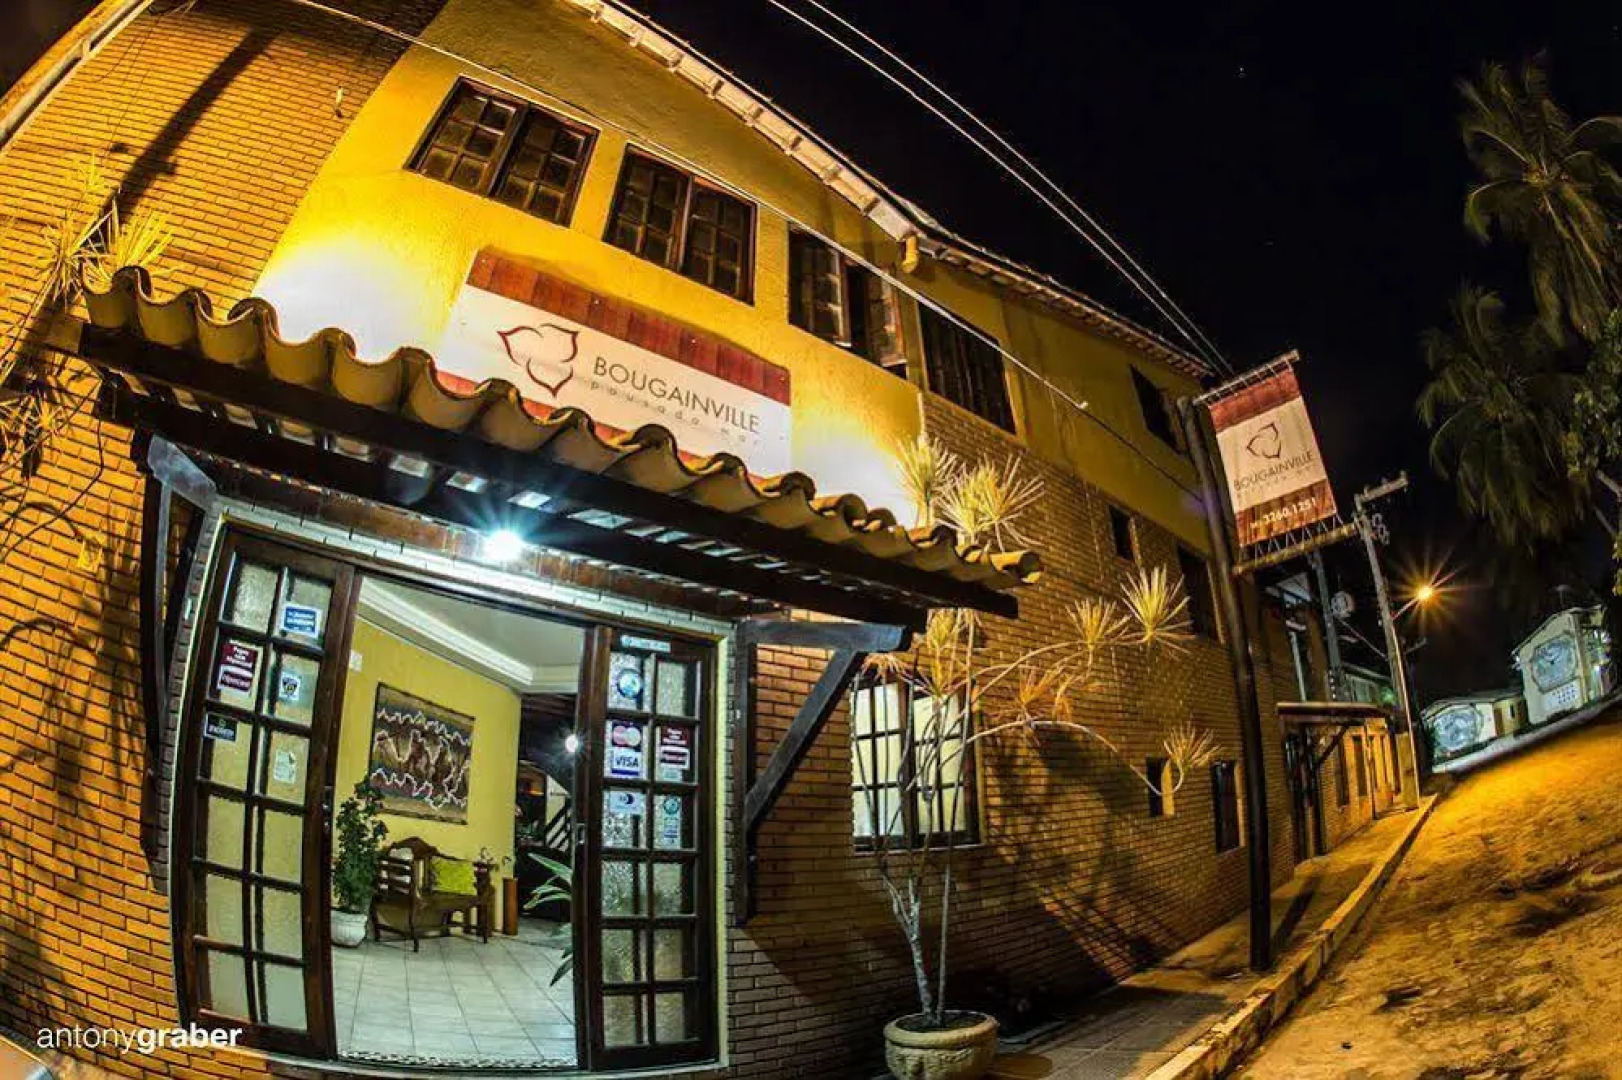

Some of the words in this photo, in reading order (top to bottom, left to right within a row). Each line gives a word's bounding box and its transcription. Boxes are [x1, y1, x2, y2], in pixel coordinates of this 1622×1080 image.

[590, 380, 700, 426] pousada
[593, 355, 760, 434] BOUGAINVILLE
[1233, 452, 1313, 490] BOUGAINVILLE
[614, 754, 640, 768] VISA
